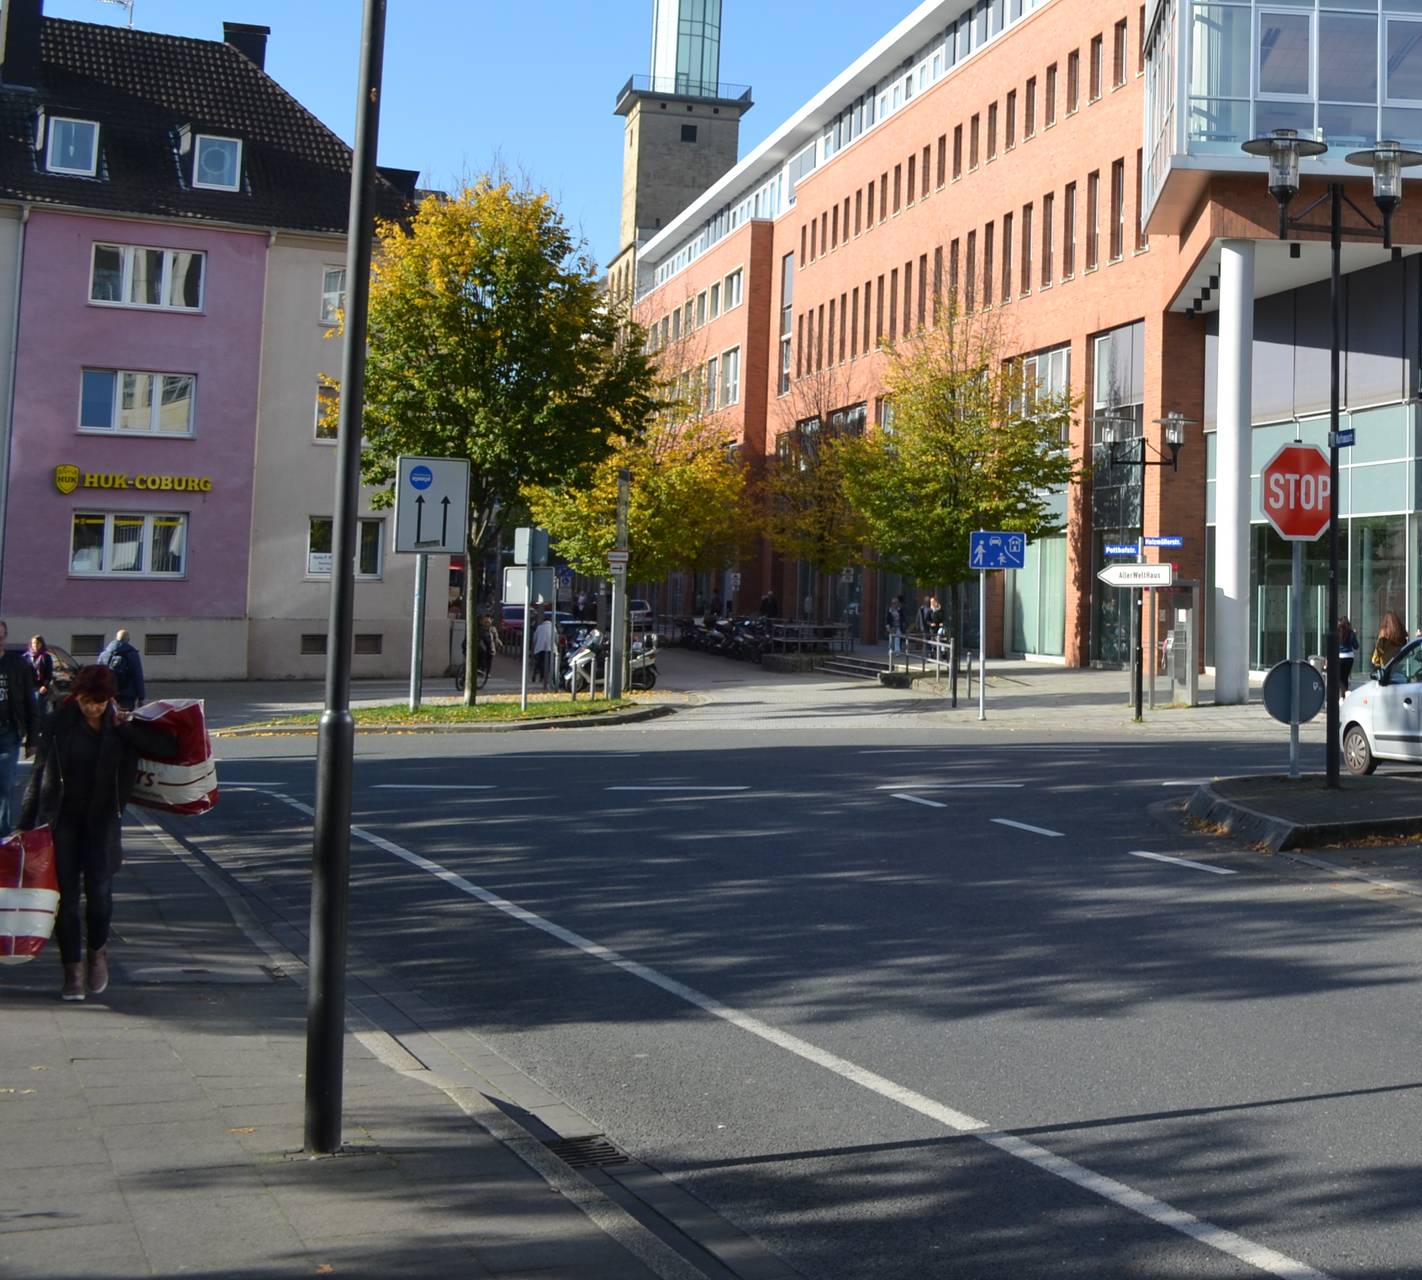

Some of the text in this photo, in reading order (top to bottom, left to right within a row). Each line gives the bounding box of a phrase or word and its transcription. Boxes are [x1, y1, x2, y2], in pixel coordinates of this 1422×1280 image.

[58, 476, 77, 484] HUK
[84, 472, 213, 492] HUK-COBURG
[1268, 472, 1330, 511] STOP
[1118, 571, 1161, 579] AllerWeltHaus
